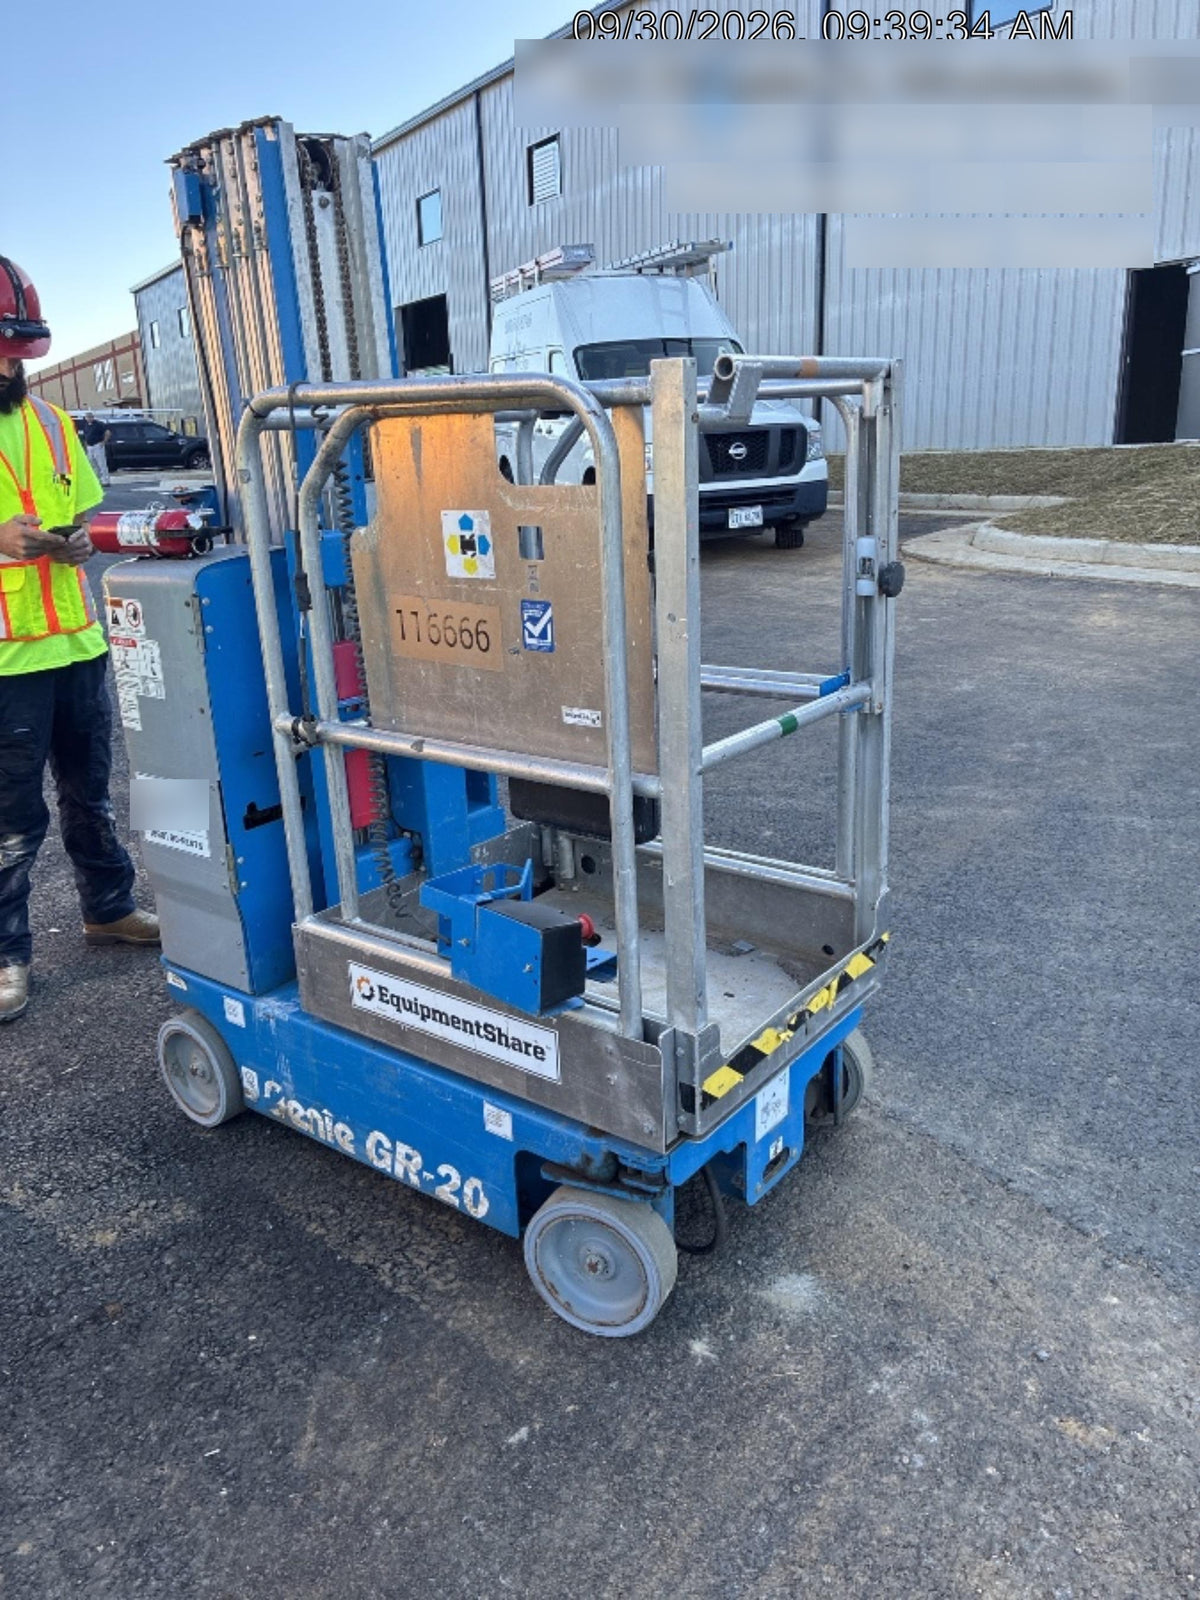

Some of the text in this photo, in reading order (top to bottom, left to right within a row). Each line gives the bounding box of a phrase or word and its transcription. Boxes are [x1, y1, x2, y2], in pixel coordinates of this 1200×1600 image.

[396, 609, 490, 653] 116666
[377, 984, 547, 1062] EquipmentShare
[365, 1130, 490, 1219] GR-20
